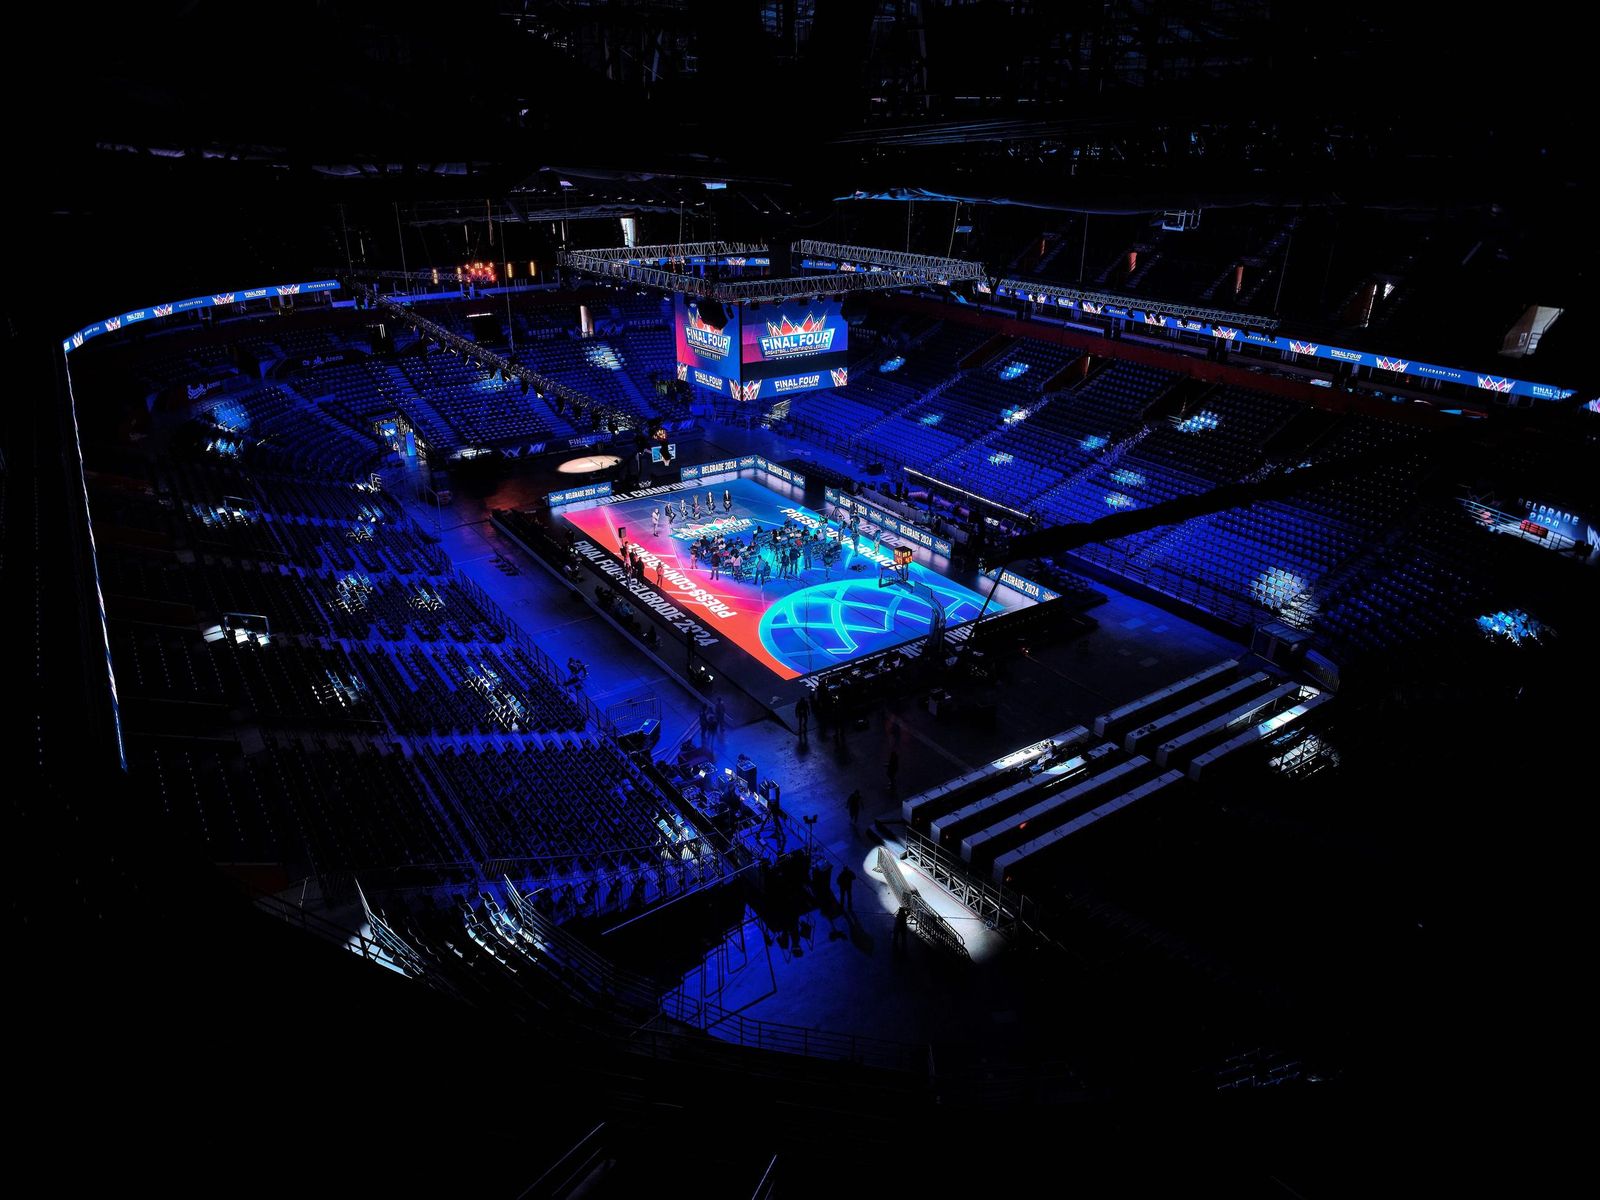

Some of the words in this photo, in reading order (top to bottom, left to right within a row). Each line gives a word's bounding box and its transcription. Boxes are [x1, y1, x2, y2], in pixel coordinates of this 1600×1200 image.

[686, 327, 707, 343] FINAL
[708, 334, 728, 349] FOUR
[762, 337, 798, 350] FINAL
[800, 331, 830, 346] FOUR
[695, 370, 709, 382] FINAL
[709, 375, 723, 386] FOUR
[774, 379, 798, 389] FINAL
[799, 375, 820, 385] FOUR
[1533, 385, 1553, 395] FINAL
[701, 463, 724, 475] BELGRADE
[724, 460, 737, 470] 2024
[565, 490, 585, 499] BELGRADE
[780, 508, 820, 528] PRESS
[899, 524, 921, 541] BELGRADE
[920, 534, 932, 546] 2024
[574, 540, 602, 565] FINAL
[1025, 583, 1040, 597] 2024
[689, 586, 737, 618] PRESS
